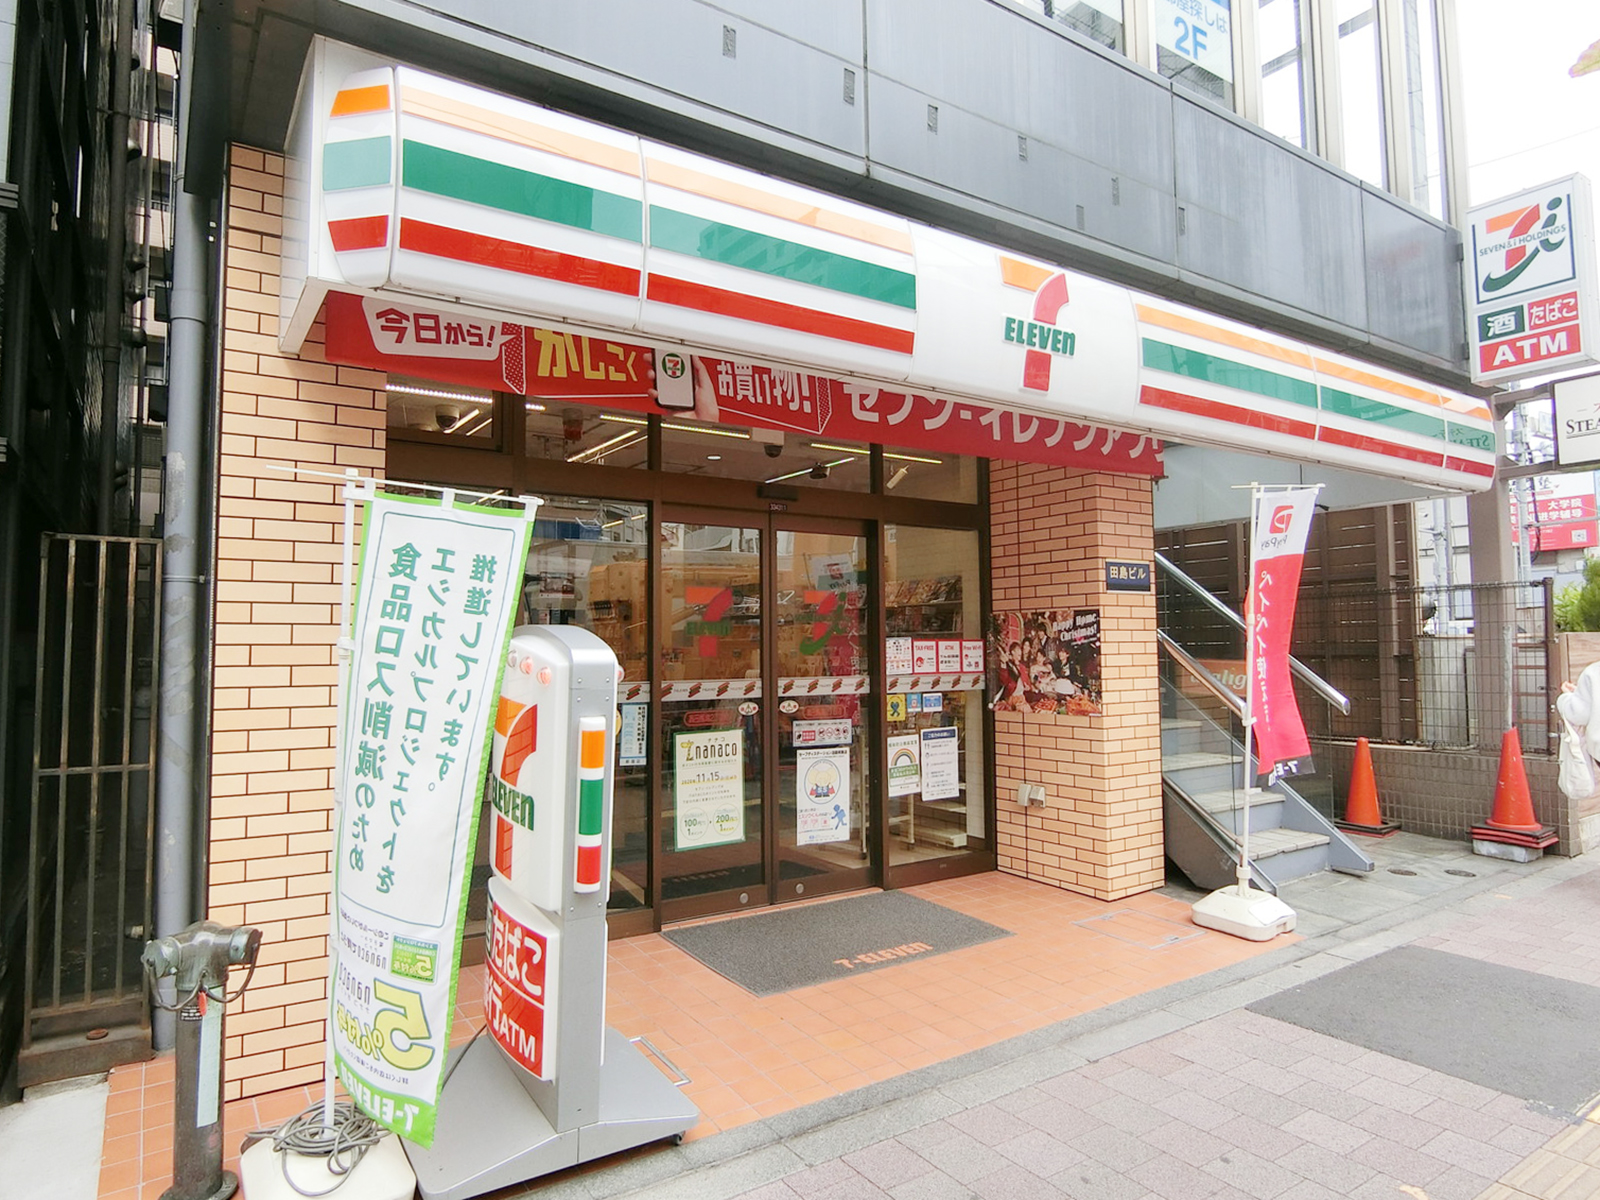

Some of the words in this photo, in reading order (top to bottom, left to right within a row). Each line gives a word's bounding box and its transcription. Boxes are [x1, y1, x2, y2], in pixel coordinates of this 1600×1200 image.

[1174, 16, 1207, 60] 2F
[1519, 224, 1567, 246] HOLDINGS
[375, 308, 496, 348] 今日から!
[1487, 311, 1517, 337] 酒
[1530, 297, 1577, 326] たばこ
[1492, 331, 1568, 366] ATM
[716, 360, 812, 414] お買い物!
[695, 742, 738, 759] nanaco
[492, 909, 543, 996] たばこ
